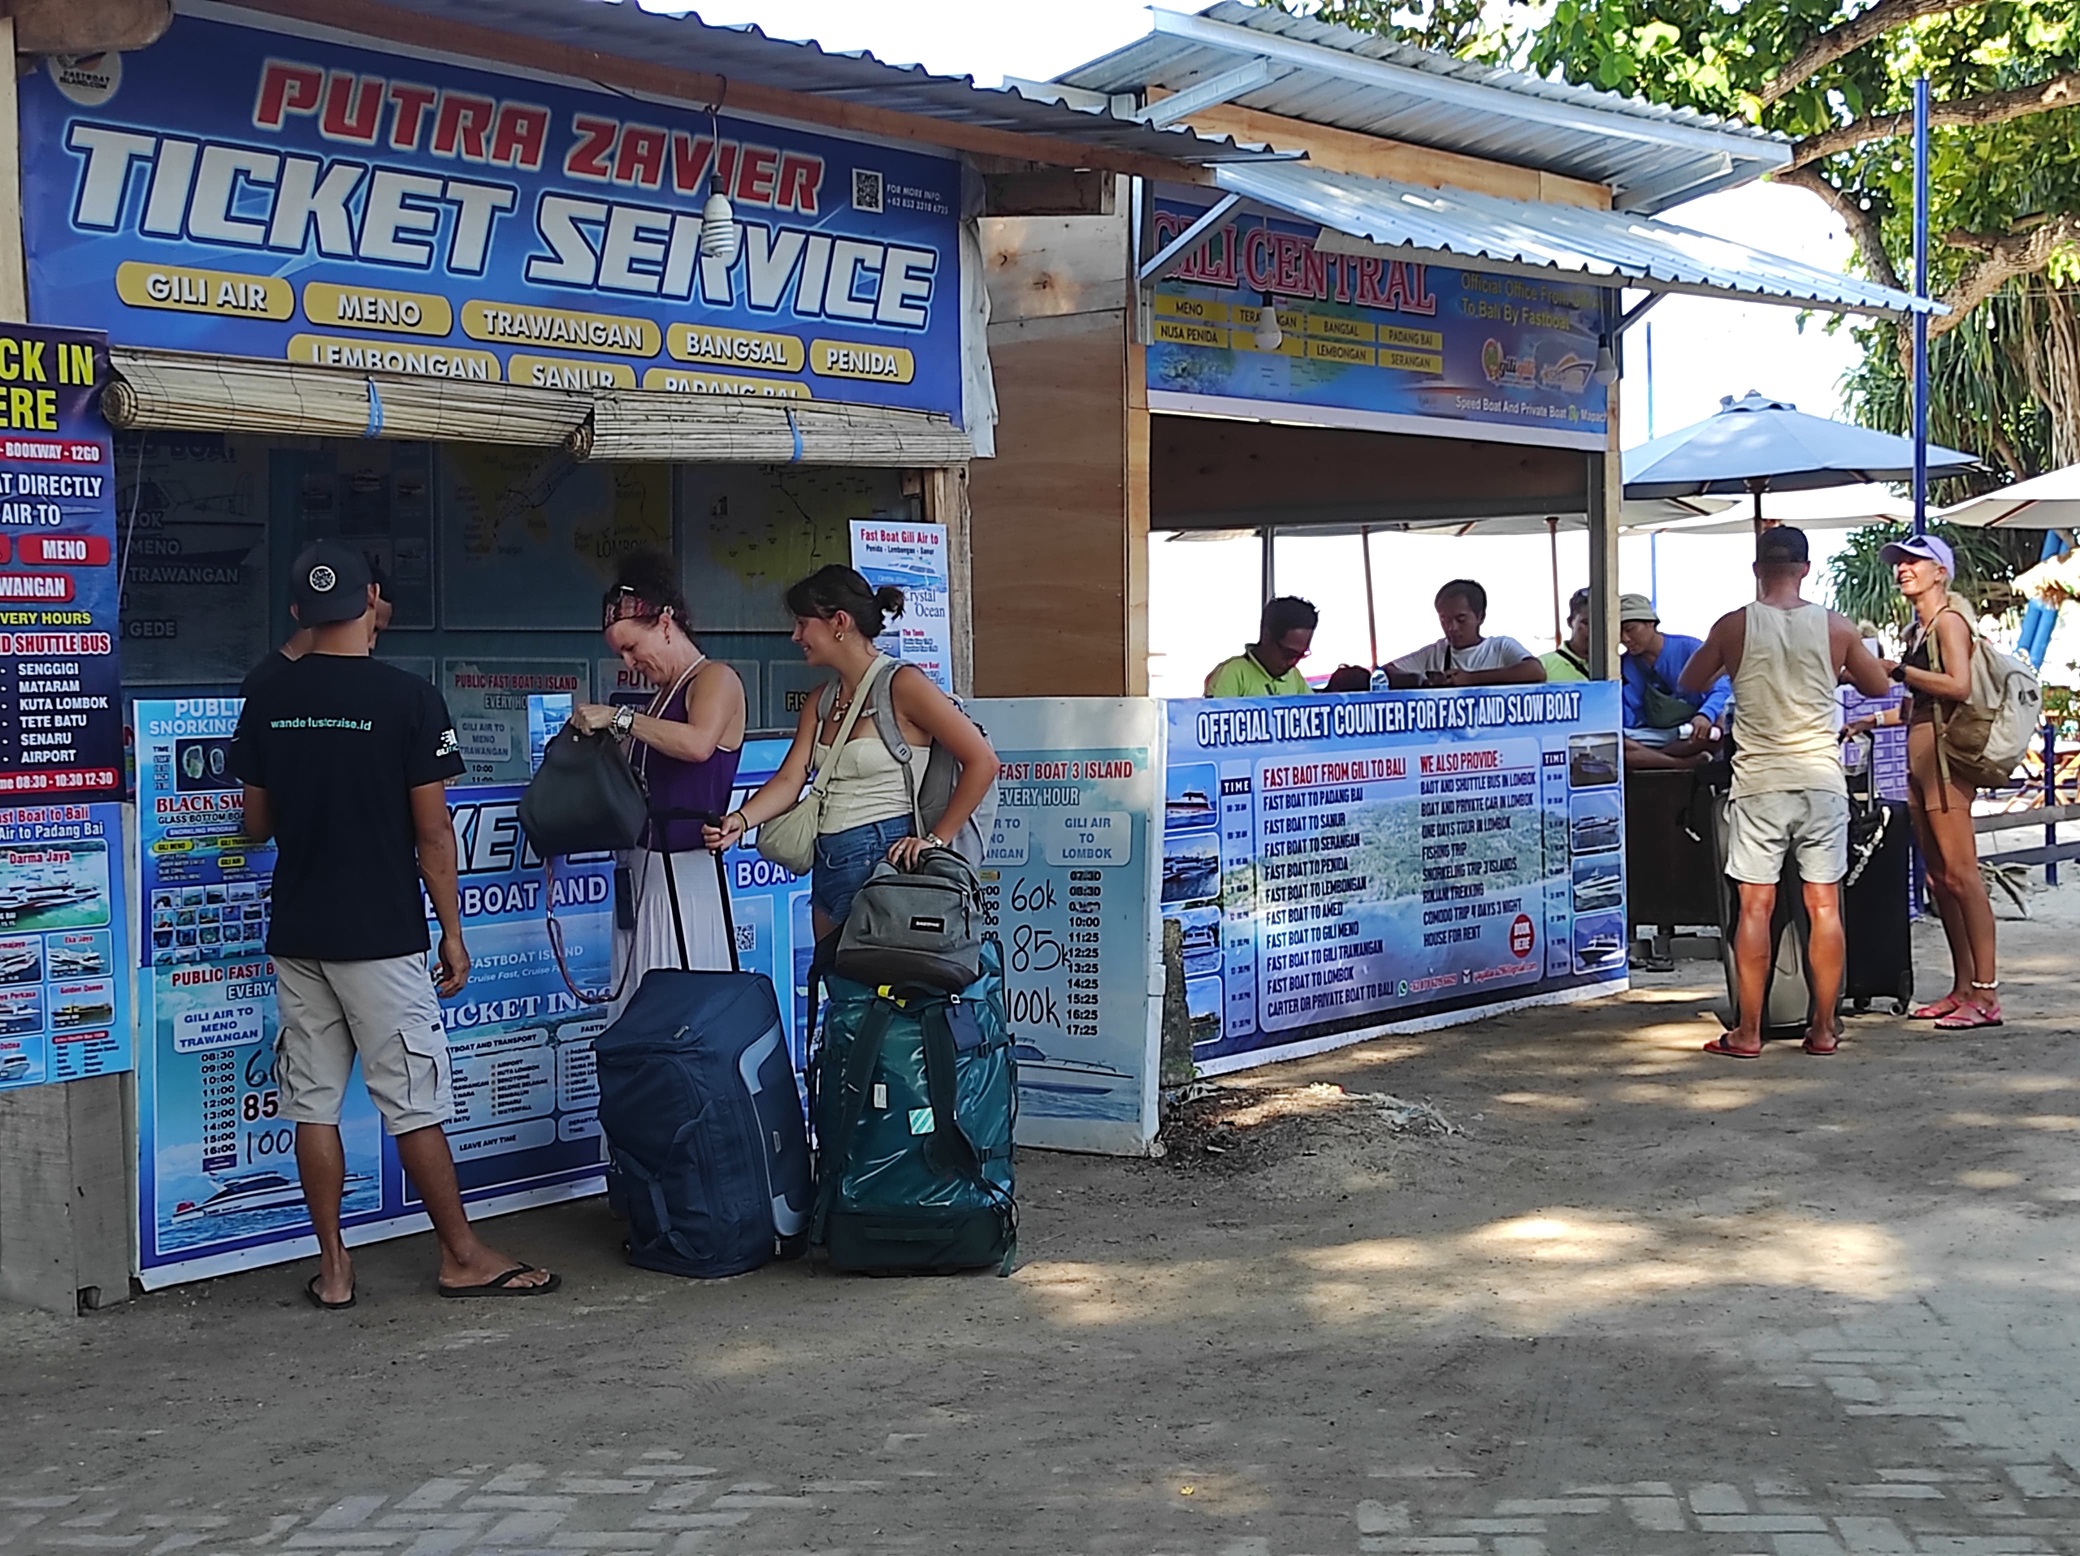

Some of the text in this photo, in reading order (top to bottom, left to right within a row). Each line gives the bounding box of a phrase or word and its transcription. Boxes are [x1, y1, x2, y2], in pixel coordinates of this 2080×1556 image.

[256, 59, 824, 214] PUTRA ZAVIER
[69, 121, 936, 329] TICKET SERVICE
[1243, 226, 1436, 315] CENTRAL
[146, 273, 268, 312] GILI AIR
[1461, 272, 1501, 294] Official
[1505, 280, 1537, 301] Office
[337, 294, 422, 326] MENO
[1176, 301, 1203, 316] MENO
[1462, 297, 1570, 330] To Bali By Fastboat
[483, 309, 643, 350] TRAWANGAN
[1161, 325, 1218, 344] NUSA PENIDA
[1324, 320, 1359, 337] BANGSAL
[1389, 329, 1433, 346] PADANG BAI
[686, 332, 787, 366] BANGSAL
[1317, 344, 1366, 361] LEMBONGAN
[57, 343, 94, 386] IN
[826, 348, 898, 377] PENIDA
[1391, 353, 1430, 368] SERANGAN
[1455, 395, 1481, 411] Speed
[1483, 398, 1501, 412] Boat
[1503, 400, 1519, 414] And
[1521, 402, 1547, 417] Private
[1550, 405, 1567, 418] Boat
[5, 442, 62, 460] BOOKWAY
[18, 474, 102, 497] DIRECTLY
[2, 502, 61, 525] AIR TO
[860, 528, 939, 545] Fast Boat Gili Air to
[42, 540, 86, 560] MENO
[903, 587, 936, 606] Crystal
[915, 602, 945, 618] Ocean
[42, 612, 92, 625] HOURS
[129, 621, 177, 637] GEDE
[15, 634, 110, 654] SHUTTLE BUS
[18, 663, 79, 675] SENGGIGI
[19, 681, 80, 693] MATARAM
[455, 674, 577, 691] PUBLIC FAST BOAT 3 ISLAND
[20, 696, 108, 711] KUTA LOMBOK
[20, 715, 87, 728] TETE BATU
[1198, 691, 1580, 746] OFFICIAL TICKET COUNTER FOR FAST AND SLOW BOAT
[21, 733, 72, 745] SENARU
[472, 735, 495, 744] MENO
[21, 750, 76, 763] AIRPORT
[460, 746, 508, 756] TRAWANGAN
[1545, 753, 1565, 765] TIME
[472, 764, 493, 773] 10:00
[1420, 750, 1498, 773] WE ALSO PROVIDE
[999, 761, 1133, 781] FAST BOAT 3 ISLAND
[1263, 757, 1406, 788] FAST BAOT FROM GILI TO BALI
[1224, 781, 1249, 793] TIME
[156, 794, 245, 813] BLACK SW
[998, 787, 1080, 806] EVERY HOUR
[18, 806, 89, 822] Boat to Bali
[158, 811, 245, 825] GLASS BOTTOM BOA
[20, 827, 31, 839] to
[36, 824, 80, 839] Padang
[84, 821, 103, 835] Bai
[1065, 817, 1111, 829] GILI AIR
[1079, 832, 1095, 843] TO
[10, 849, 70, 864] Darma Jaya
[1062, 847, 1112, 859] LOMBOK
[1069, 916, 1100, 928] 10:00
[1068, 932, 1099, 943] 11:25
[1423, 925, 1481, 948] HOUSE FOR RENT
[1068, 947, 1099, 959] 12:25
[172, 964, 260, 987] PUBLIC FAST
[468, 973, 496, 985] Cruise
[522, 966, 549, 977] Cruise
[1068, 962, 1099, 974] 13:25
[228, 982, 271, 1000] EVERY
[1067, 978, 1098, 989] 14:25
[1067, 993, 1098, 1005] 15:25
[184, 1007, 254, 1024] GILI AIR TO
[1066, 1009, 1098, 1020] 16:25
[201, 1021, 238, 1034] MENO
[1066, 1024, 1097, 1035] 17:25
[180, 1029, 258, 1048] TRAWANGAN
[201, 1050, 235, 1062] 08:30
[201, 1062, 235, 1074] 09:00
[202, 1074, 235, 1086] 10:00
[202, 1085, 236, 1097] 11:00
[202, 1097, 236, 1109] 12:00
[203, 1109, 236, 1121] 13:00
[203, 1120, 236, 1132] 14:00
[203, 1132, 236, 1144] 15:00
[459, 1134, 516, 1151] LEAVE ANY TIME
[203, 1143, 236, 1156] 16:00
